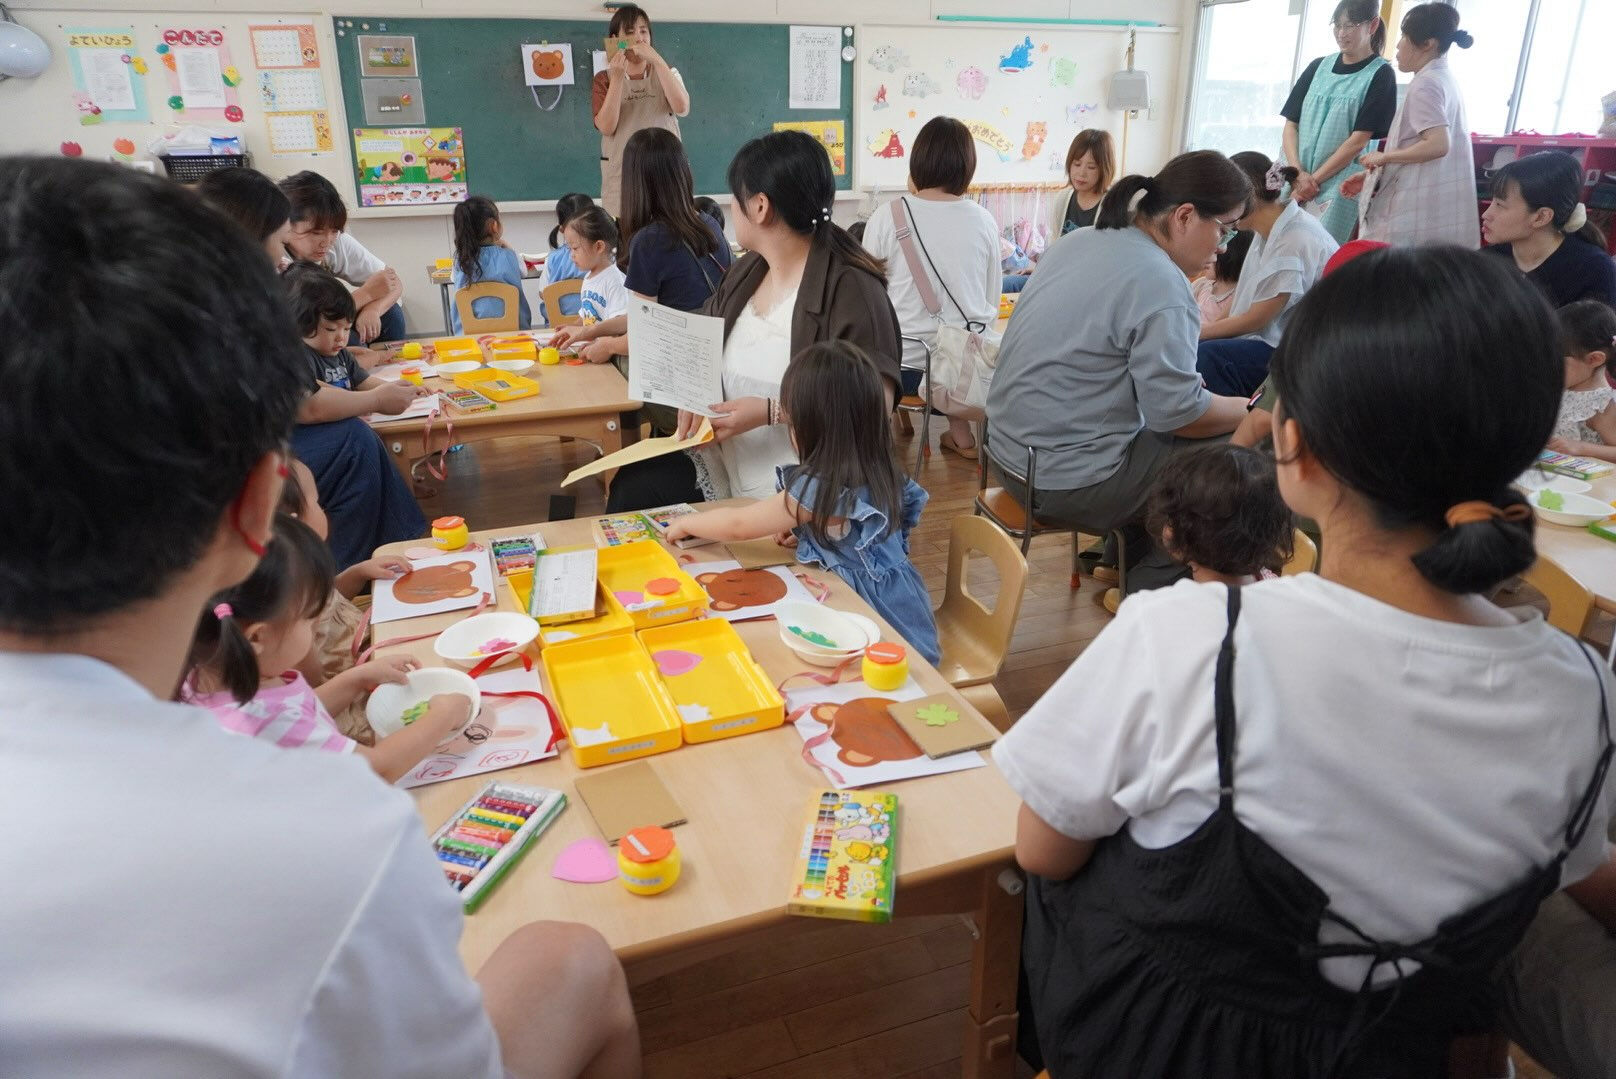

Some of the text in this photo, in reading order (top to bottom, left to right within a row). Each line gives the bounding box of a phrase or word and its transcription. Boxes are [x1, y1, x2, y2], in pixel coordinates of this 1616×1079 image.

[69, 35, 132, 46] よていひょう
[165, 31, 222, 45] こんだて
